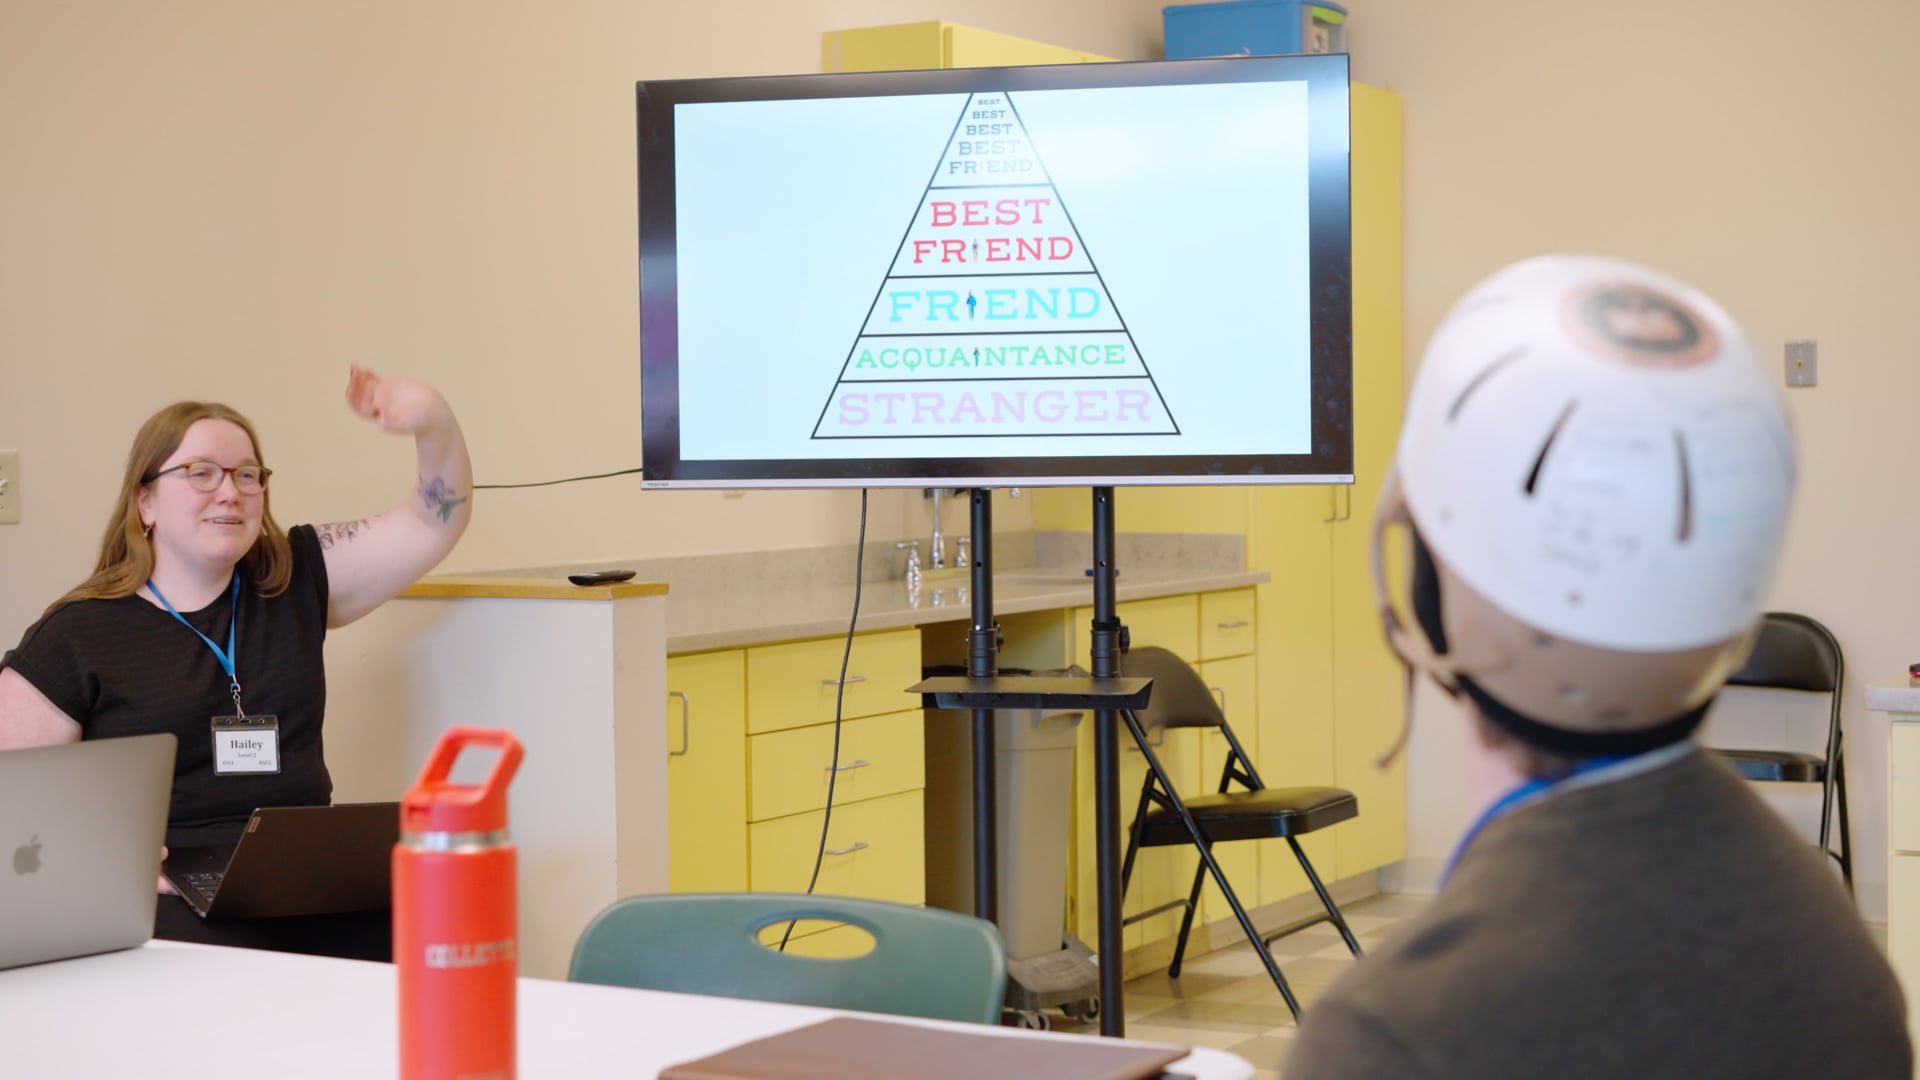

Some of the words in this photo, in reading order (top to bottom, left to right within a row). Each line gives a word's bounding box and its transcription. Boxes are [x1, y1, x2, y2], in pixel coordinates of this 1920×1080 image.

[972, 110, 1006, 119] BEST
[966, 123, 1013, 135] BEST
[958, 140, 1021, 156] BEST
[931, 199, 1051, 227] BEST
[838, 390, 1151, 425] STRANGER
[230, 740, 263, 751] Hailey
